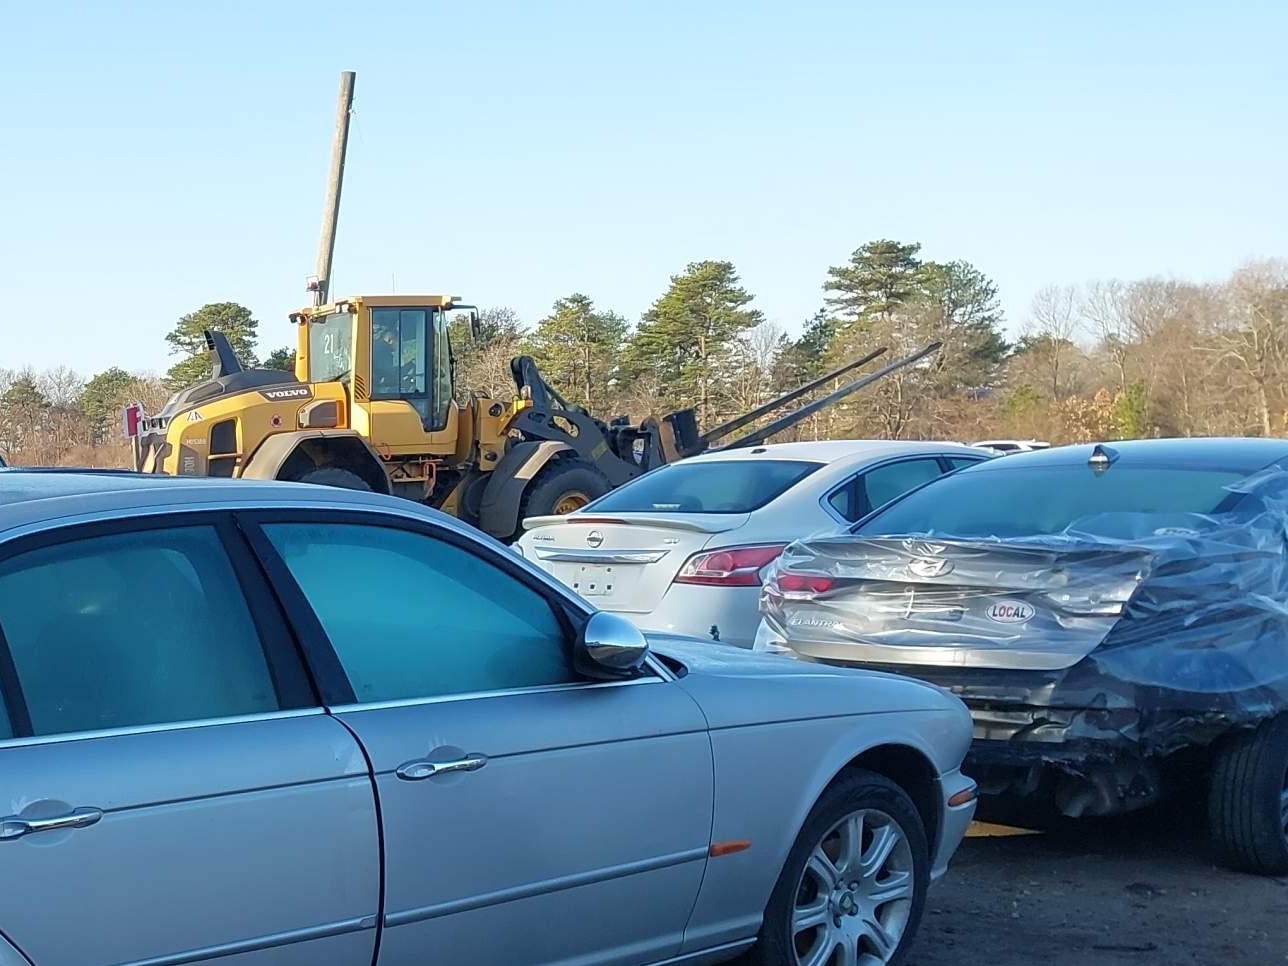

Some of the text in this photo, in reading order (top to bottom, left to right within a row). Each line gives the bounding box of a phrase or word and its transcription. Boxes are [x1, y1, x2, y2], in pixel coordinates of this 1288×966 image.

[324, 334, 333, 354] 21
[265, 389, 308, 398] VOLVO
[992, 605, 1027, 618] LOCAL
